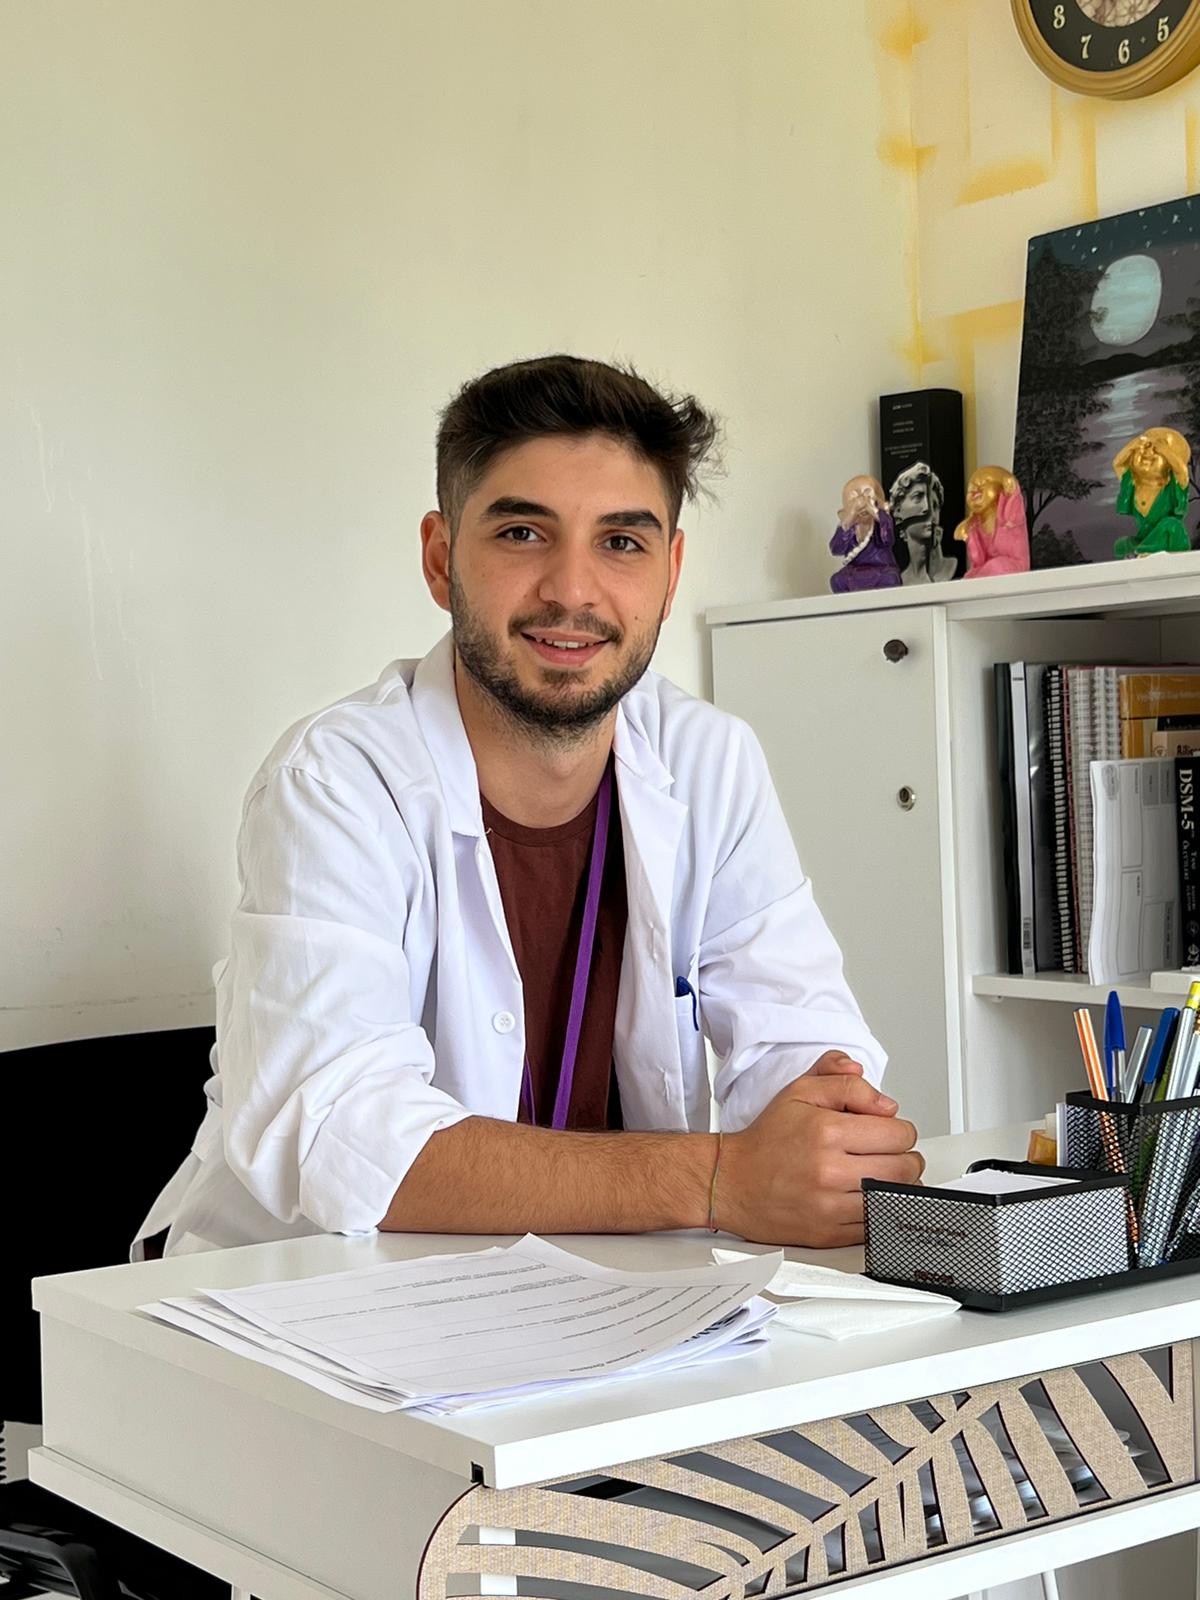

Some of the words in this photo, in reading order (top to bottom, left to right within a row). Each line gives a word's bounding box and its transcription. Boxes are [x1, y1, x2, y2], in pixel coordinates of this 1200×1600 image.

[1053, 4, 1066, 30] 8
[1157, 16, 1169, 43] 5
[1080, 34, 1092, 60] 7
[1118, 39, 1131, 65] 6
[1179, 769, 1195, 831] DSM-5
